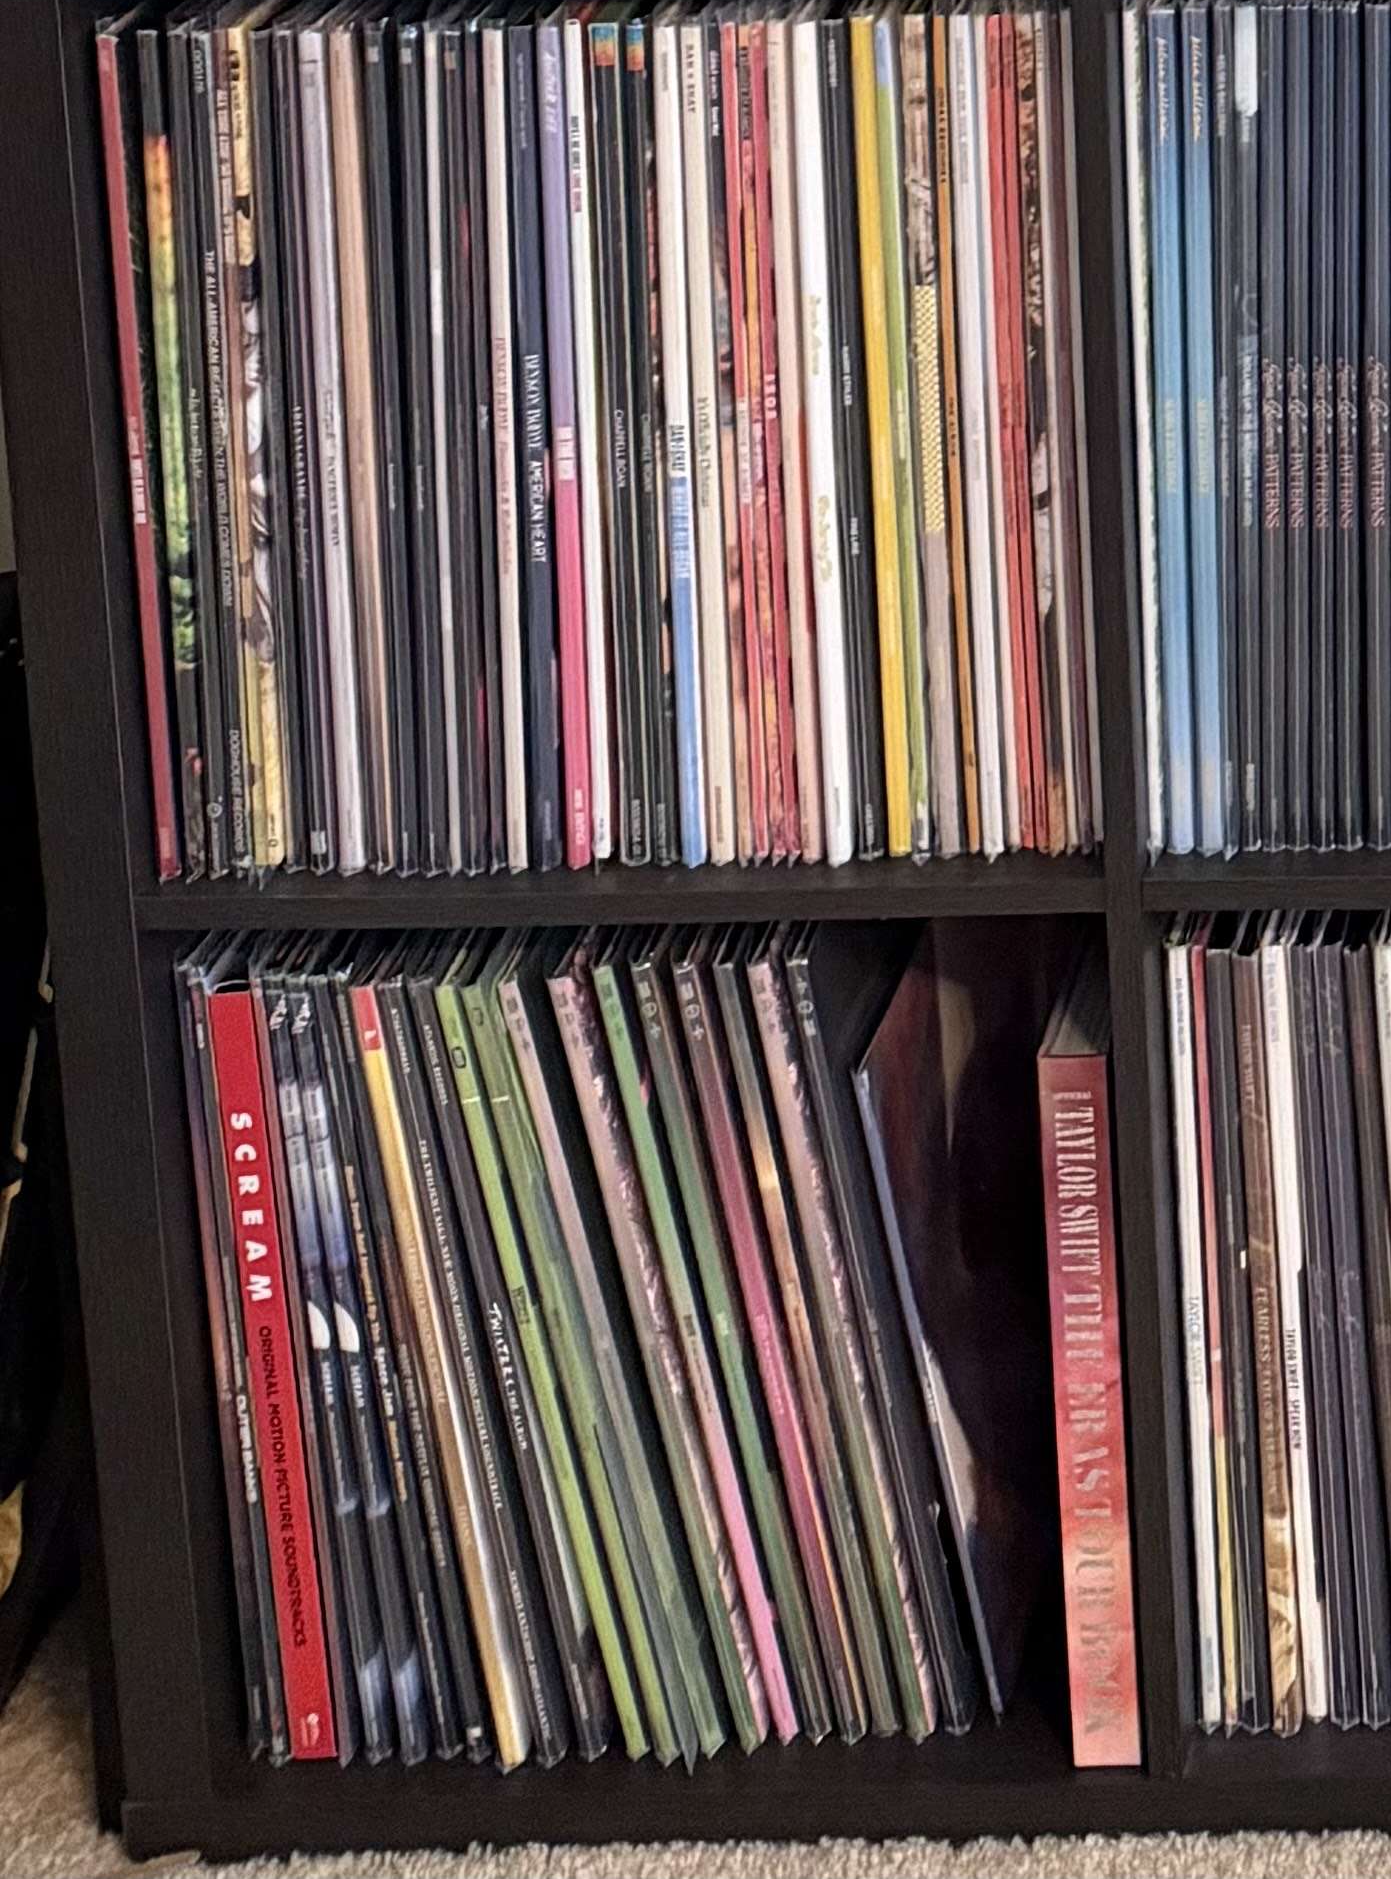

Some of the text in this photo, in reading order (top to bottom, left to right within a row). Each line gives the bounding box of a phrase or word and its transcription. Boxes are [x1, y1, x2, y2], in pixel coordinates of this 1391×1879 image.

[615, 409, 627, 488] CHAPPELL ROAN
[528, 460, 546, 563] AMERICAN HEART
[1265, 453, 1280, 529] PATTERNS
[1290, 453, 1304, 529] PATTERNS
[1314, 453, 1329, 529] PATTERNS
[1339, 453, 1353, 529] PATTERNS
[1371, 451, 1385, 528] PATTERNS
[1053, 1106, 1100, 1198] TAYLOR
[229, 1112, 272, 1302] SCREAM
[1059, 1203, 1101, 1276] SWIFT
[431, 1067, 448, 1106] RECORDS
[513, 1412, 530, 1450] ALBUM
[256, 1325, 279, 1399] ORIGINAL
[1257, 1286, 1273, 1362] FEARLESS
[1285, 1328, 1299, 1360] TAYLOR
[374, 1346, 396, 1416] Space Jam
[1287, 1362, 1299, 1390] SWIFT
[234, 1394, 258, 1503] OUTER BANKS
[262, 1403, 287, 1465] MOTION
[470, 1397, 502, 1510] PICTURE SOUNDTRACK
[1067, 1382, 1113, 1491] ERAS
[1289, 1427, 1301, 1451] NOW
[272, 1468, 295, 1532] PICTURE
